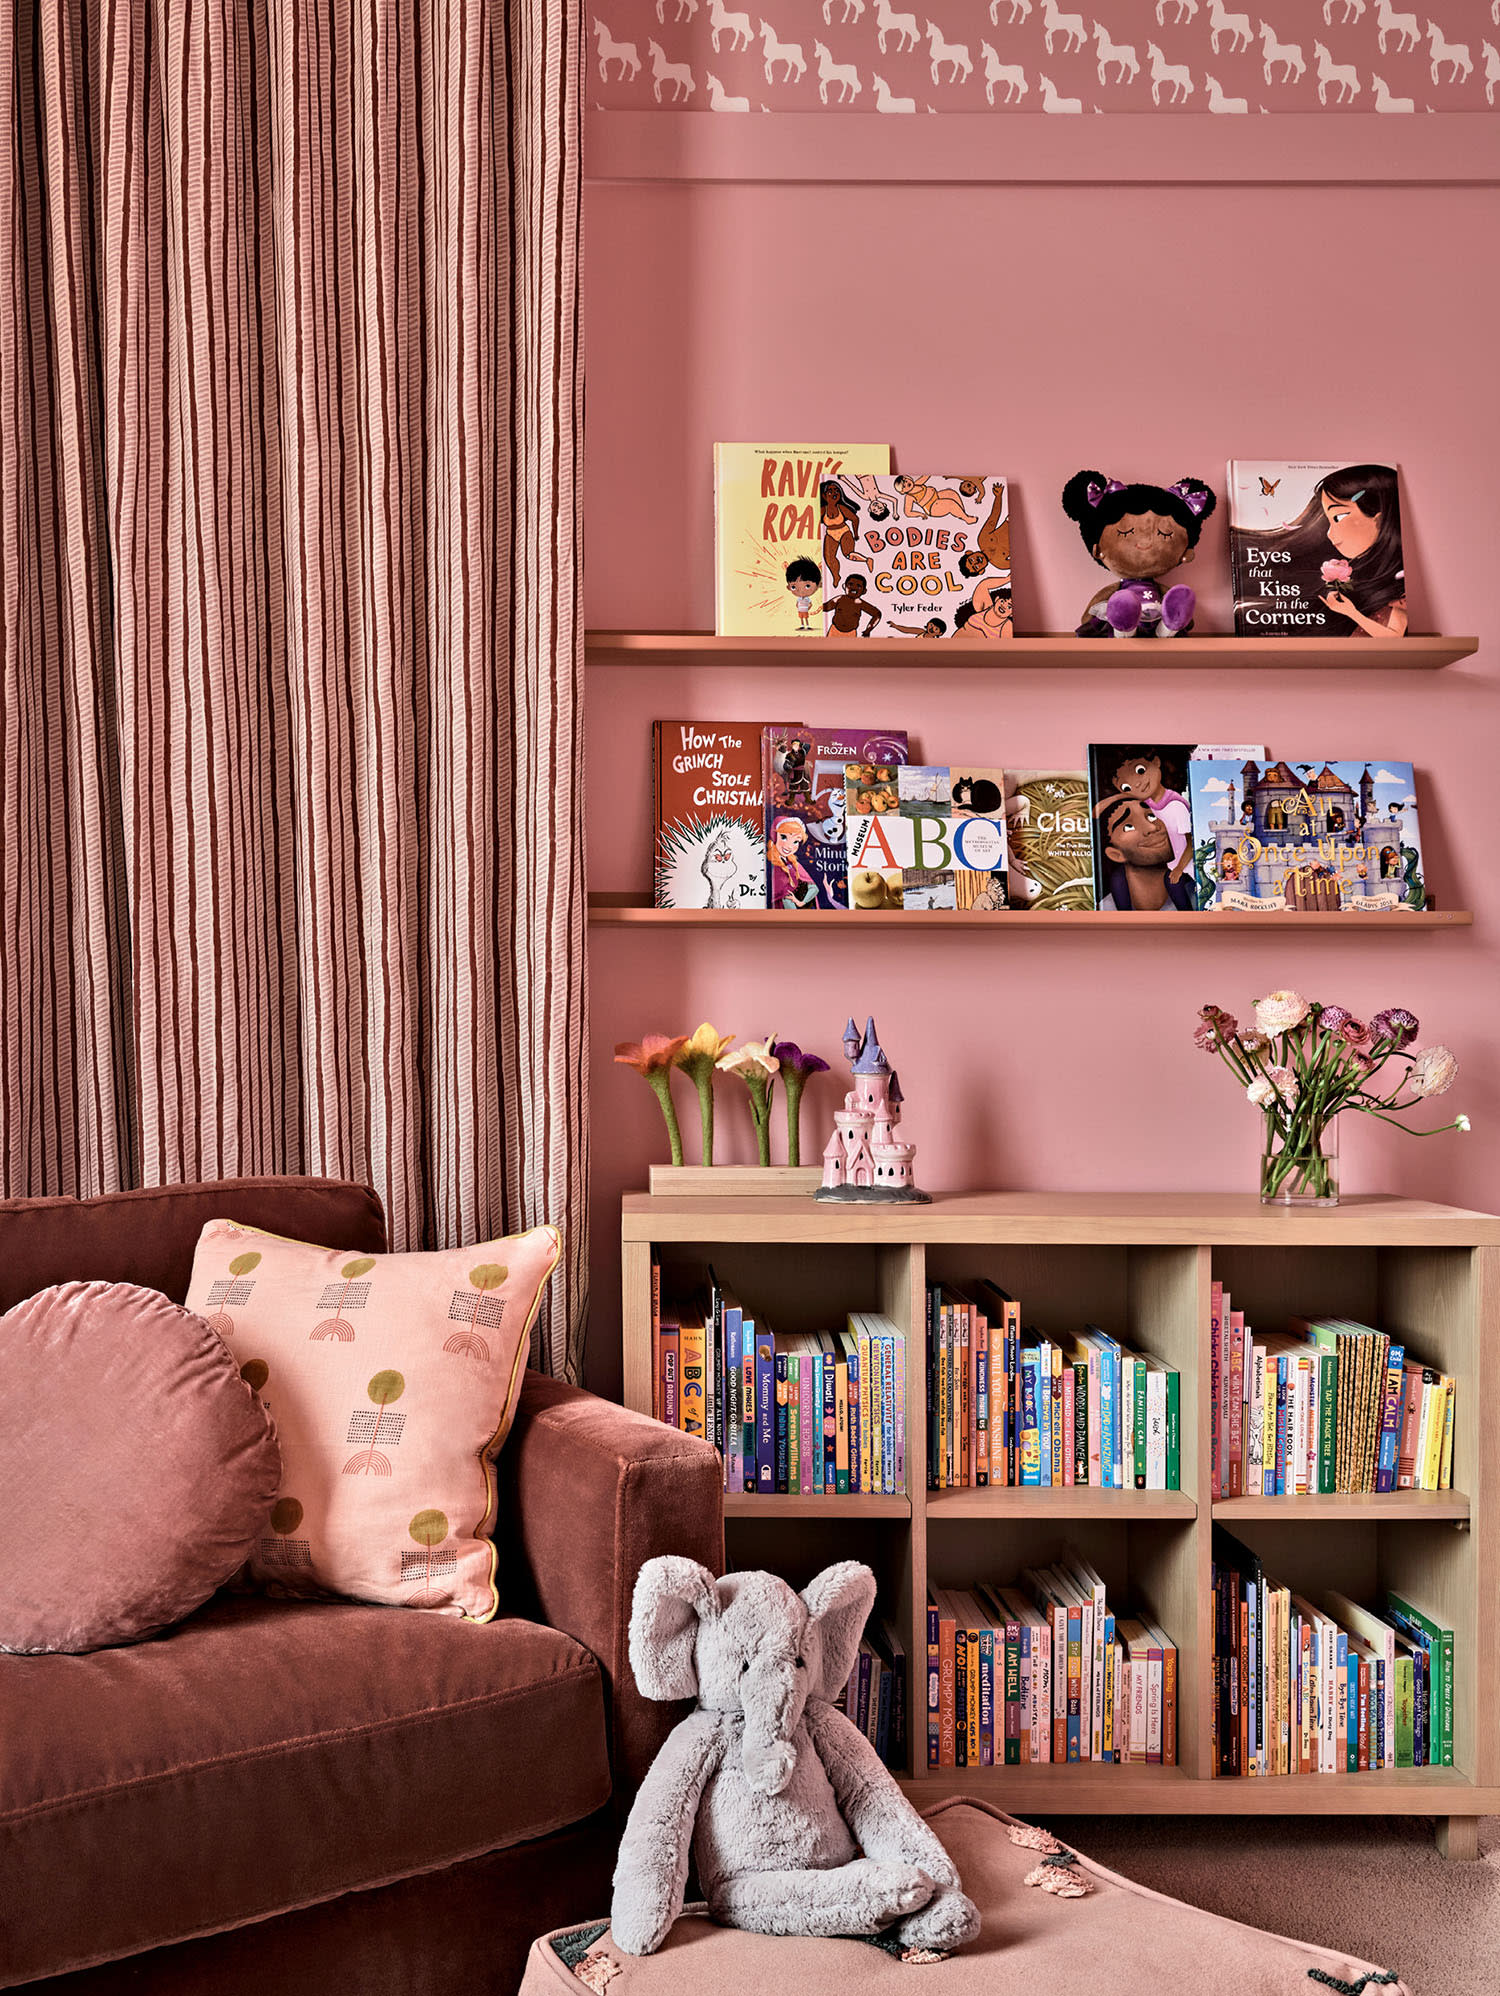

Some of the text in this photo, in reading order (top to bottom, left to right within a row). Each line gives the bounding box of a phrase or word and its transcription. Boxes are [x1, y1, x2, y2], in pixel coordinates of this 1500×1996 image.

[763, 503, 821, 542] ROA
[865, 527, 967, 552] BODIES
[892, 551, 941, 570] ARE
[1247, 548, 1291, 567] Eyes
[875, 572, 963, 595] COOL
[1249, 566, 1272, 577] that
[1260, 581, 1300, 596] Kiss
[892, 603, 942, 613] Tyler Feder
[1276, 598, 1308, 609] in the
[1246, 610, 1325, 624] Corners
[719, 735, 742, 748] The
[817, 746, 856, 755] FROZEN
[673, 754, 723, 773] GRINCH
[712, 771, 751, 786] STOLE
[693, 787, 764, 806] CHRISTMA
[1281, 788, 1334, 817] All
[1037, 813, 1089, 832] Clau
[1300, 823, 1316, 836] at
[851, 815, 1002, 871] ABC
[852, 819, 870, 856] MUSEUM
[1239, 827, 1379, 871] Once Upon
[815, 848, 846, 859] Minu
[739, 884, 756, 896] Dr.
[1273, 868, 1353, 896] a Time
[1211, 1318, 1219, 1399] Chicka Chicka
[825, 1374, 834, 1403] Diwali
[1025, 1370, 1033, 1411] MY BOOK
[1255, 1356, 1263, 1399] Alphabetimals
[1388, 1379, 1398, 1395] AM
[666, 1384, 674, 1415] AROUND
[761, 1373, 770, 1410] Mommy
[1231, 1352, 1241, 1445] ABC WHAT CAN SHE BE?
[992, 1355, 1001, 1461] WILL YOU SUNSHINE
[1384, 1397, 1396, 1427] CALM
[979, 1420, 985, 1429] US
[1075, 1385, 1086, 1460] WOODLAND DANCE!
[763, 1429, 770, 1443] Me
[790, 1409, 798, 1480] Serena Williams
[1276, 1410, 1284, 1479] Misty Copeland
[1103, 1432, 1111, 1472] AMAZING!
[956, 1644, 966, 1670] NO!
[1007, 1652, 1017, 1666] AM
[1007, 1669, 1017, 1696] WELL
[1136, 1674, 1142, 1685] MY
[1166, 1658, 1174, 1692] Yoga Bug
[981, 1663, 991, 1725] meditation
[1021, 1676, 1029, 1710] Bedtime
[1150, 1683, 1159, 1708] Spring
[943, 1659, 953, 1755] GRUMPY MONKEY
